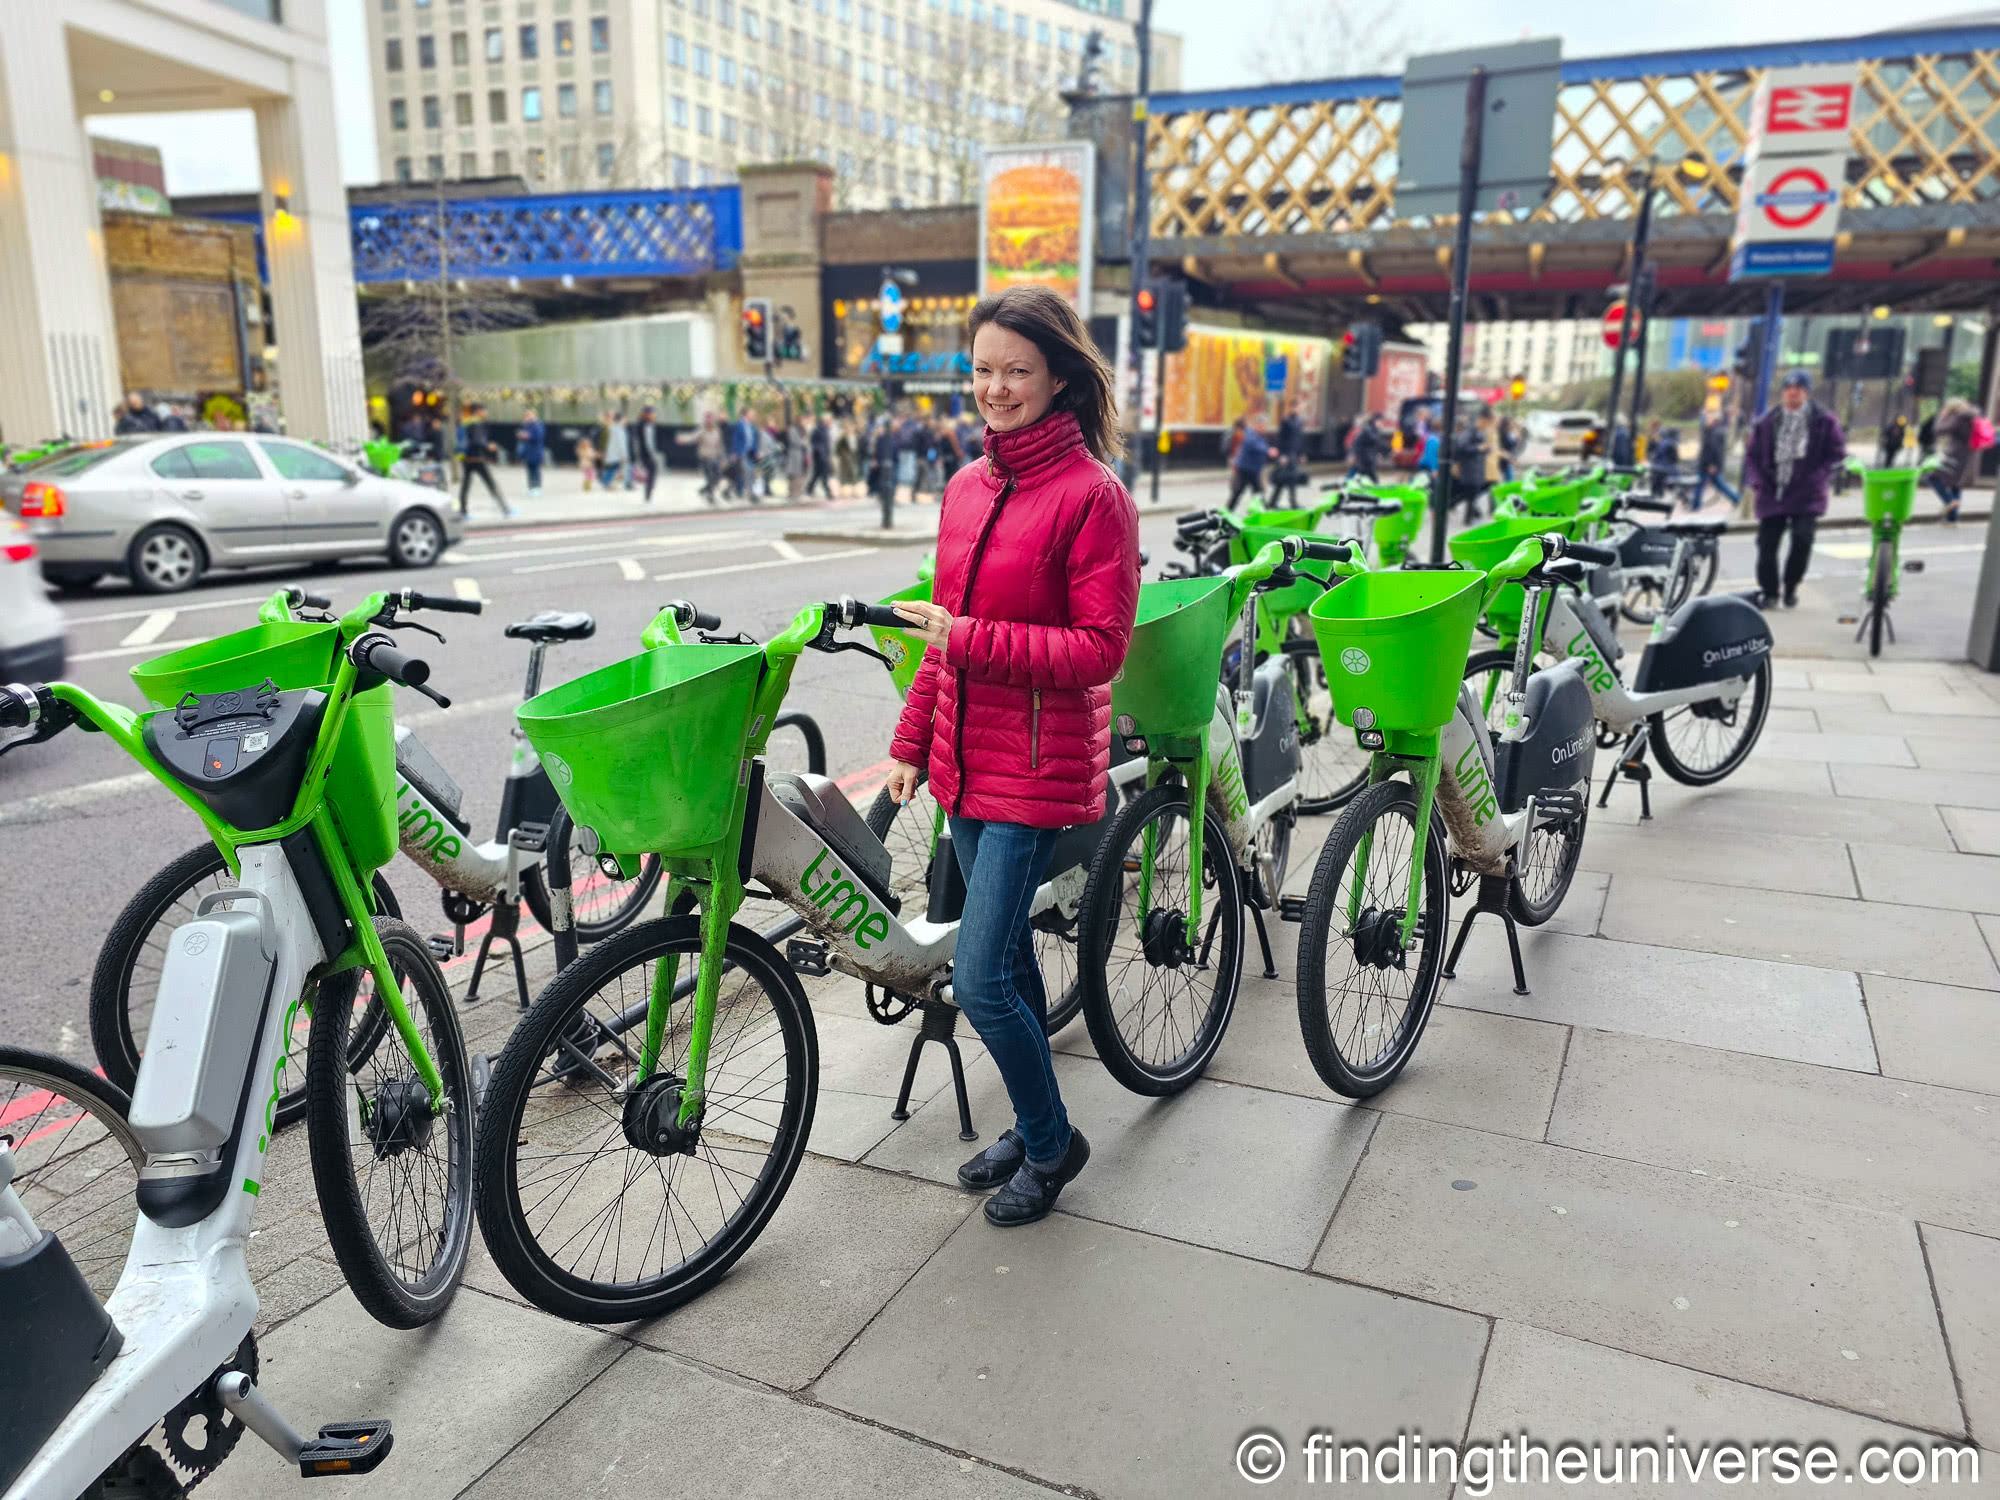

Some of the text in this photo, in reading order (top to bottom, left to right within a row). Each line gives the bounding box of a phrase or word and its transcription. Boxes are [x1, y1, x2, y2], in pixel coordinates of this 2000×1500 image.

[1567, 628, 1613, 694] Lime
[1703, 649, 1721, 664] On
[1720, 645, 1743, 661] Lime
[1217, 740, 1248, 822] Lime
[1455, 740, 1496, 827] Lime
[1552, 747, 1567, 764] On
[1566, 738, 1584, 758] Lime
[799, 846, 889, 950] Lime
